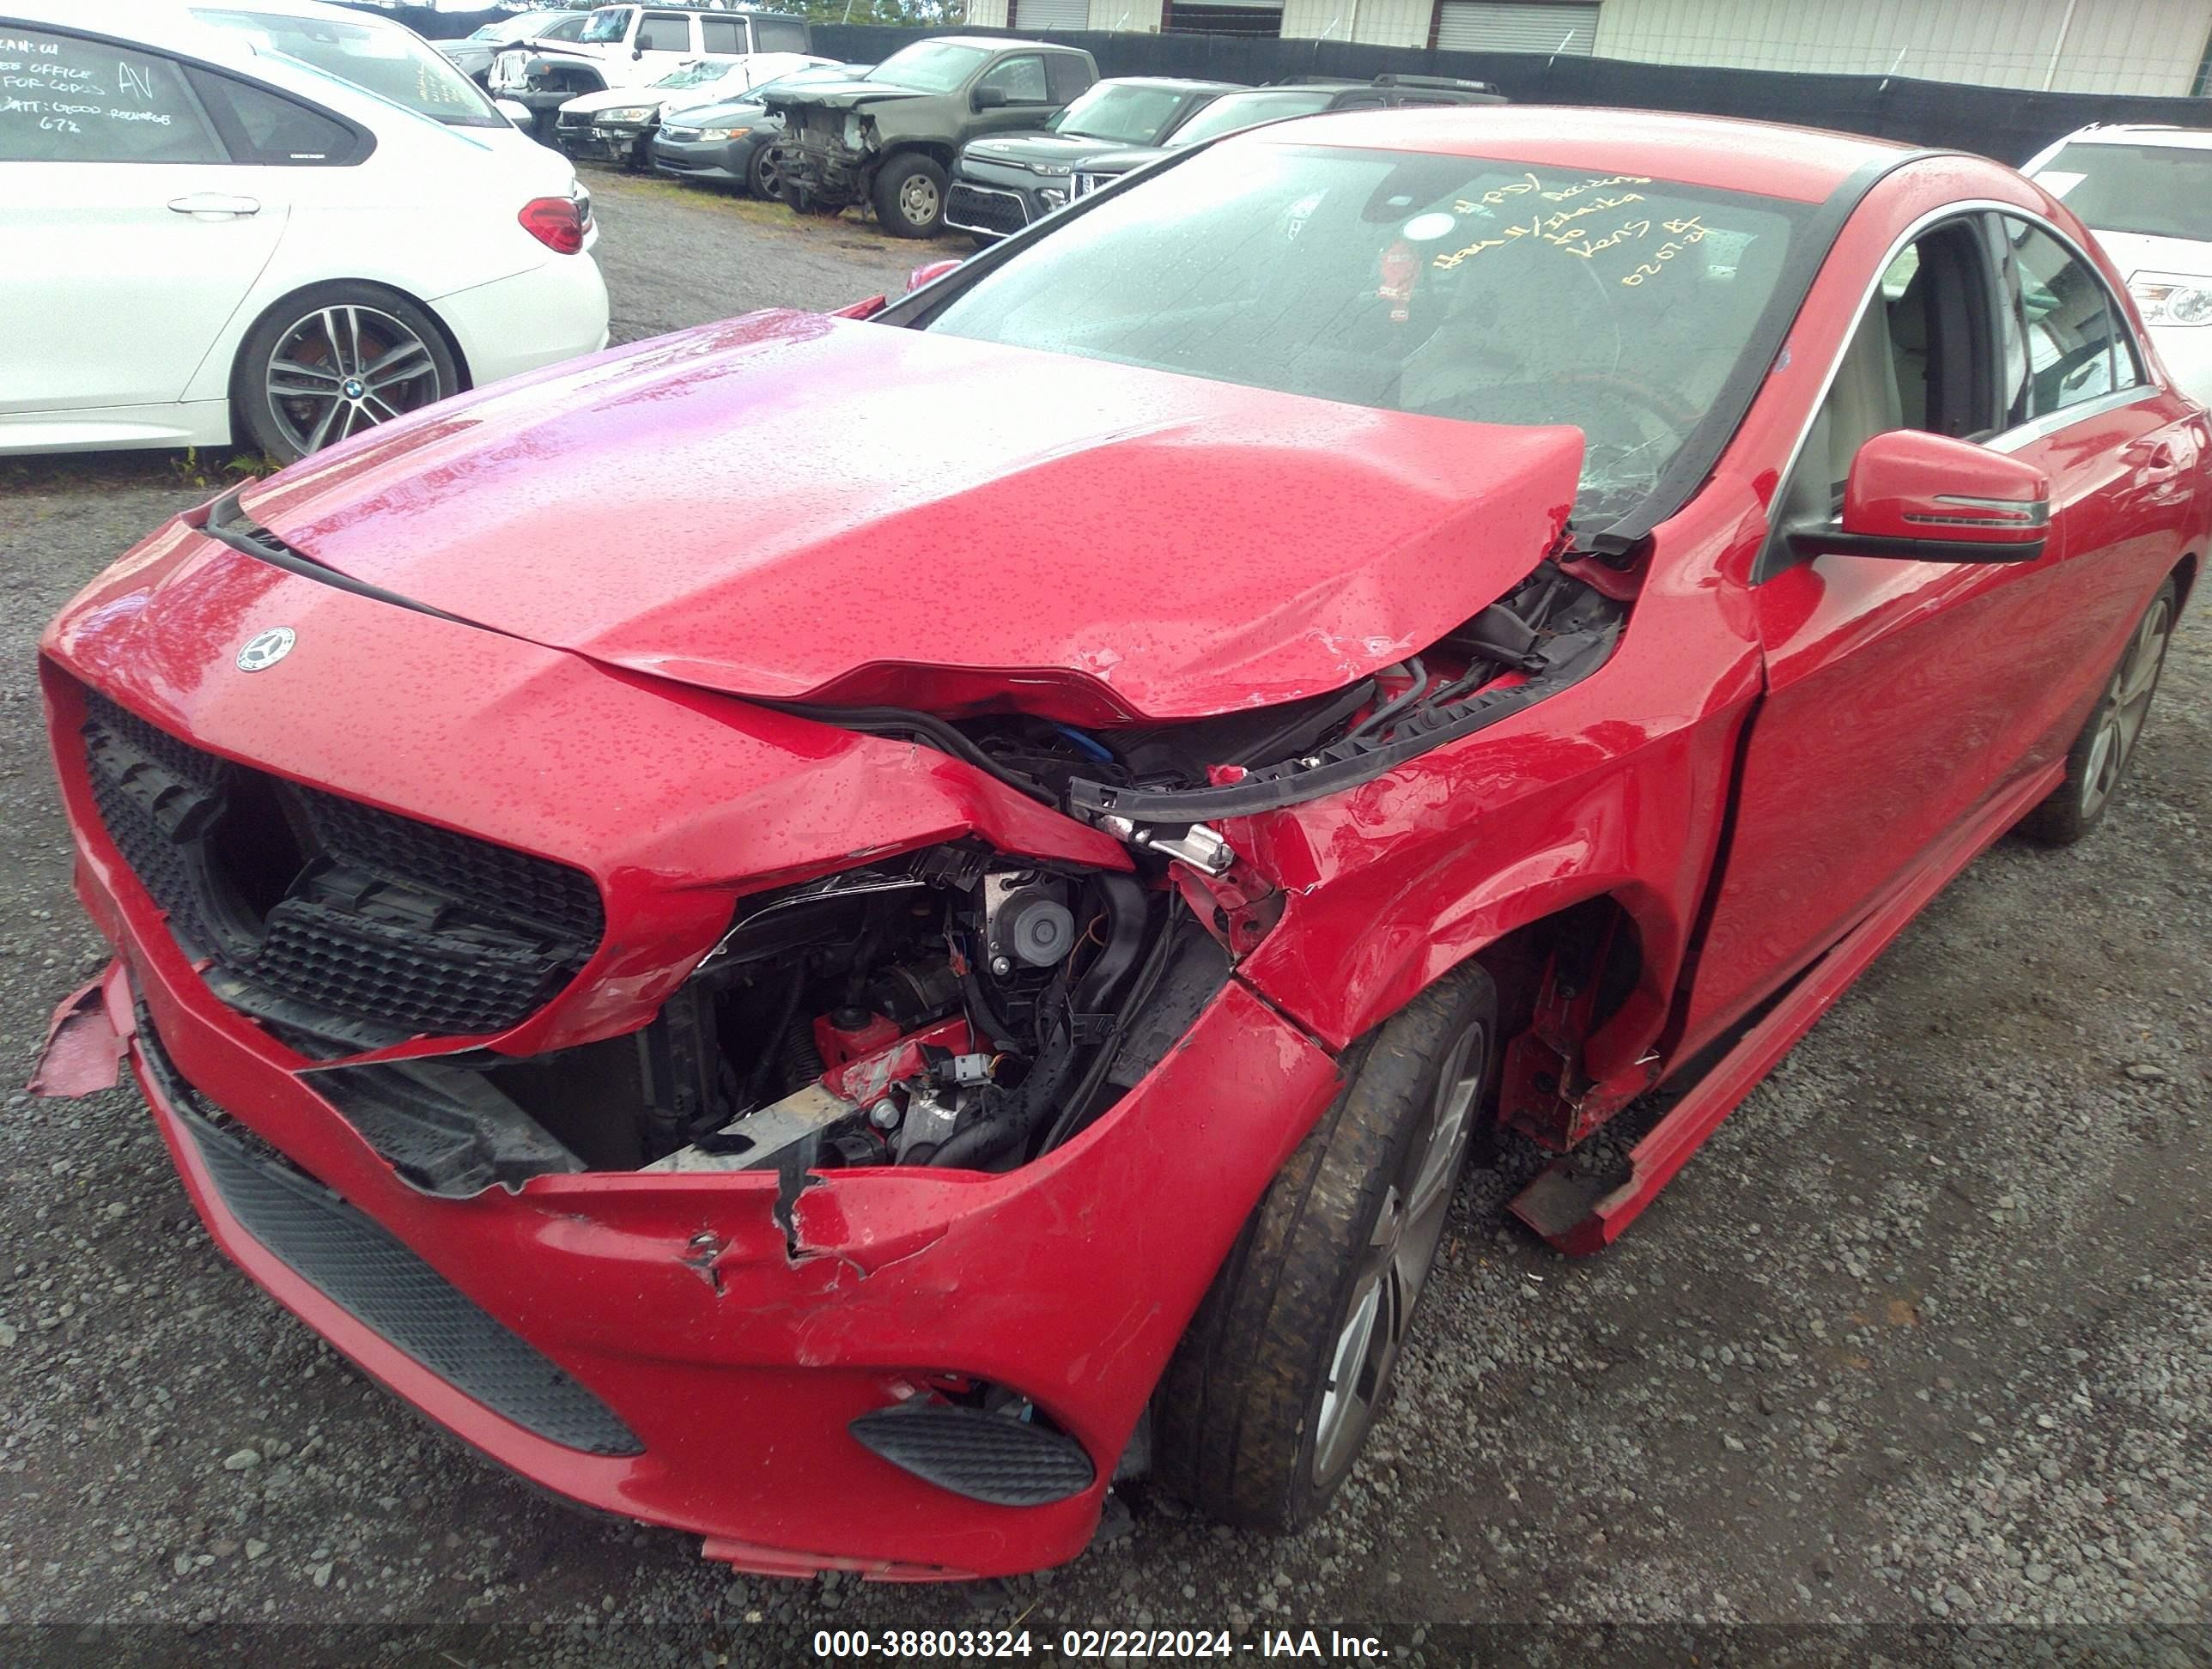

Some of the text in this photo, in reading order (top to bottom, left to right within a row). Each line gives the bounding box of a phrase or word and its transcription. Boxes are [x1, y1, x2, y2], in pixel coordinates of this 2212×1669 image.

[29, 64, 92, 79] OFFICE
[3, 76, 45, 88] FOR
[118, 61, 153, 99] AV
